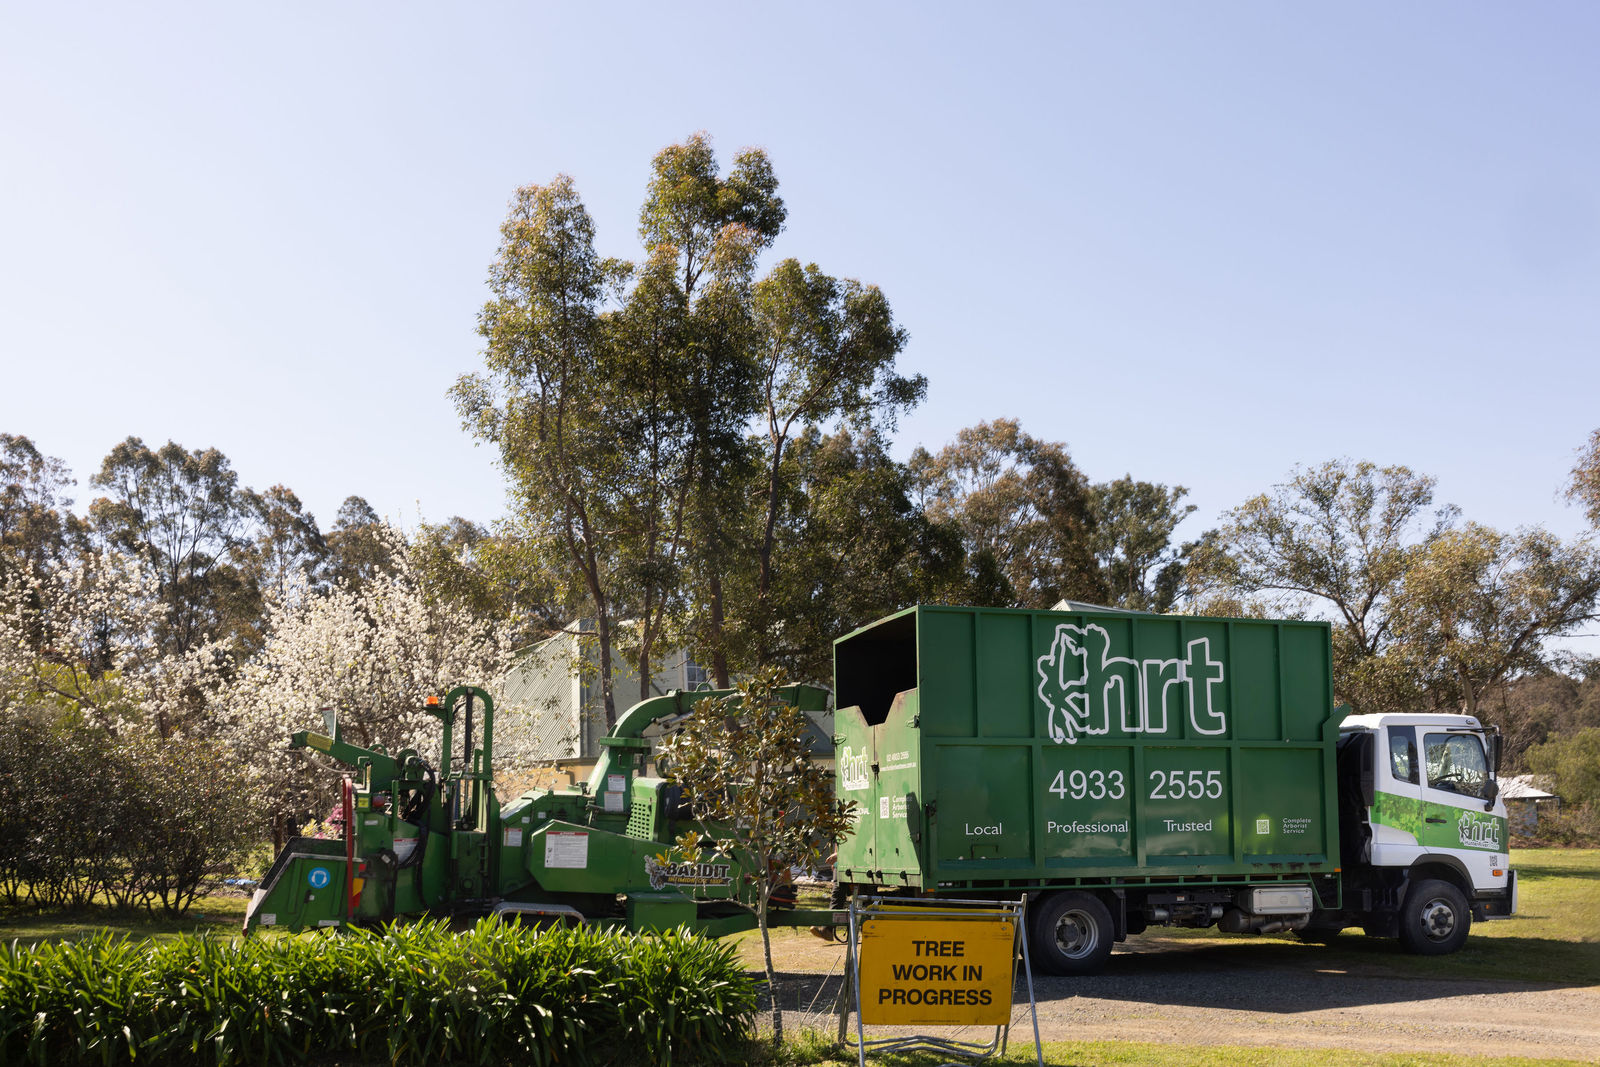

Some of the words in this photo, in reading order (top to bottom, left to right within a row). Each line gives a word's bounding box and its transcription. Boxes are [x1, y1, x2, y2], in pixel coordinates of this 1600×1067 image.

[1049, 769, 1125, 800] 4933
[1150, 770, 1223, 800] 2555
[965, 823, 1002, 835] Local
[1047, 820, 1129, 833] Professional
[1163, 819, 1212, 832] Trusted
[666, 863, 730, 878] BANDIT
[911, 940, 965, 957] TREE
[892, 964, 957, 981] WORK
[963, 965, 982, 981] IN
[878, 988, 992, 1006] PROGRESS
